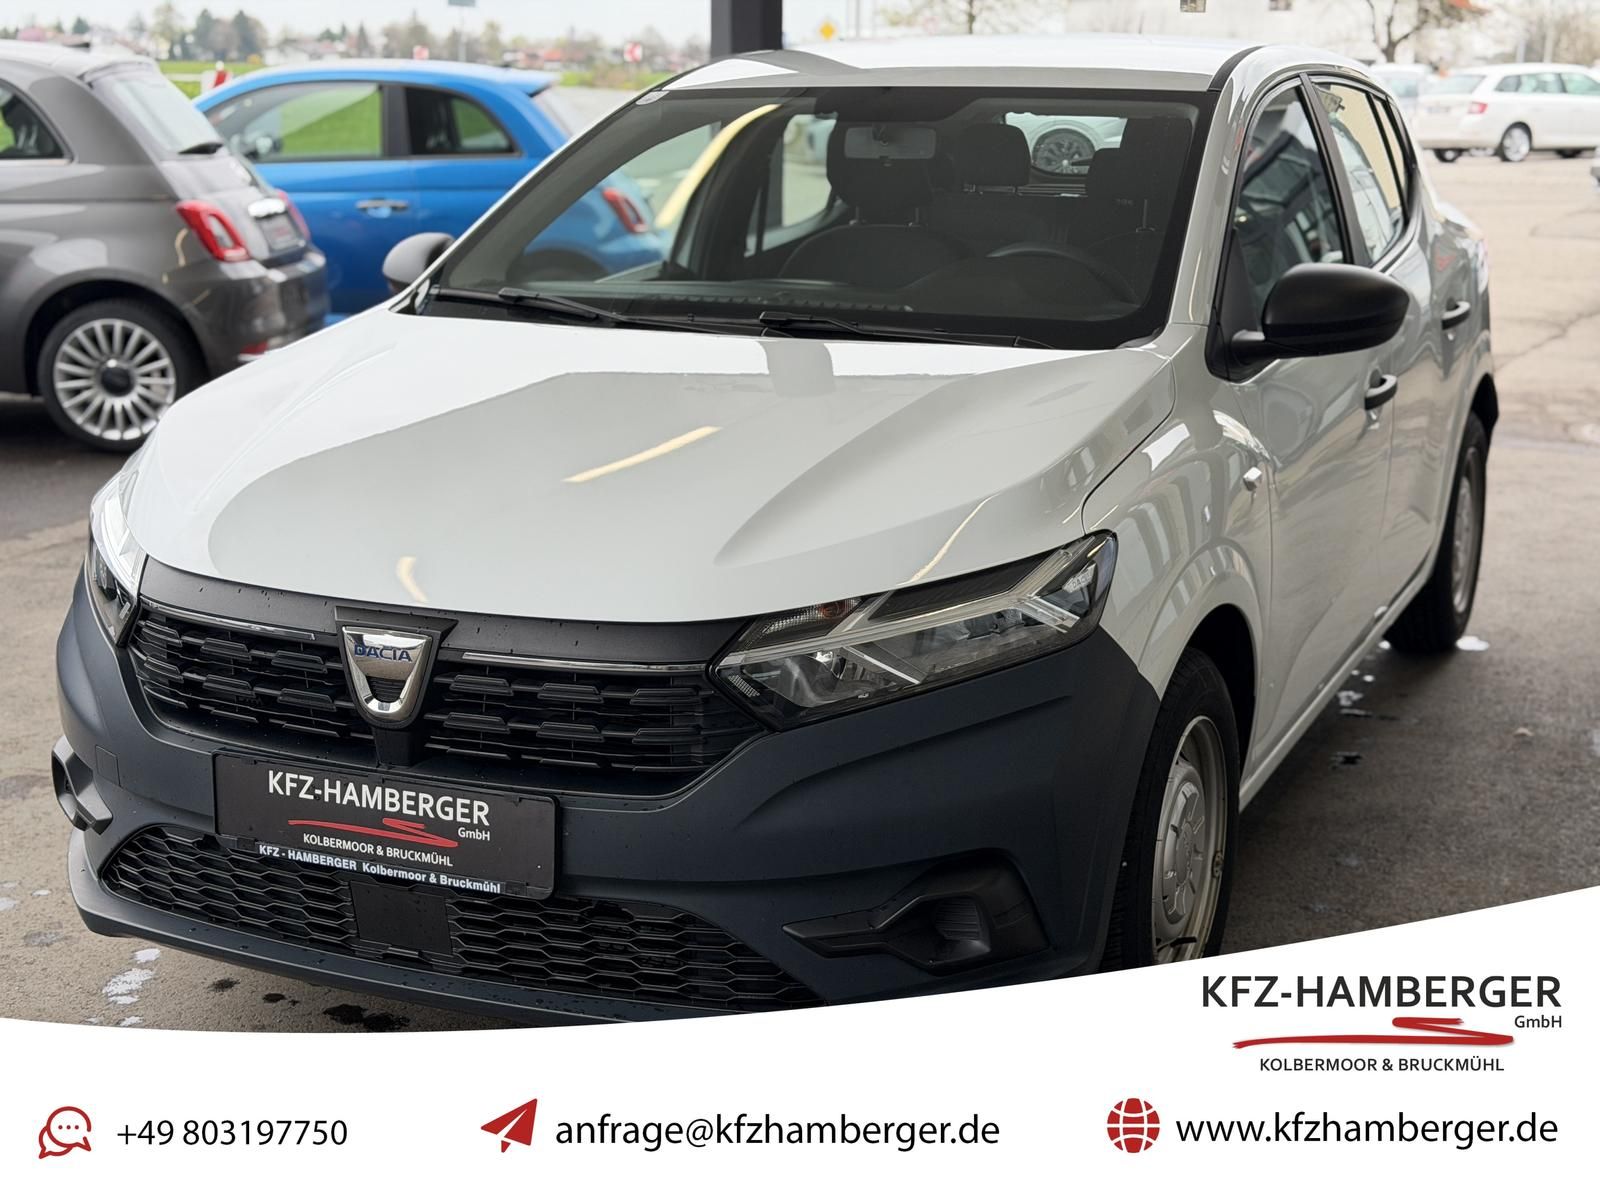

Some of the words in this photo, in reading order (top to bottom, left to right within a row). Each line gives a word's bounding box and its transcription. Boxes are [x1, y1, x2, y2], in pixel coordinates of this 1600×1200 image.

[354, 644, 412, 661] DACIA
[268, 770, 490, 826] KFZ-HAMBERGER
[303, 833, 374, 855] KOLBERMOOR
[376, 845, 384, 856] &
[386, 847, 453, 867] BRUCKMÜHL
[457, 827, 491, 841] GmbH
[259, 845, 280, 857] KFZ
[288, 850, 357, 871] HAMBERGER
[362, 862, 427, 880] Kolbermoor
[429, 873, 437, 884] &
[439, 875, 500, 894] Bruckmühl
